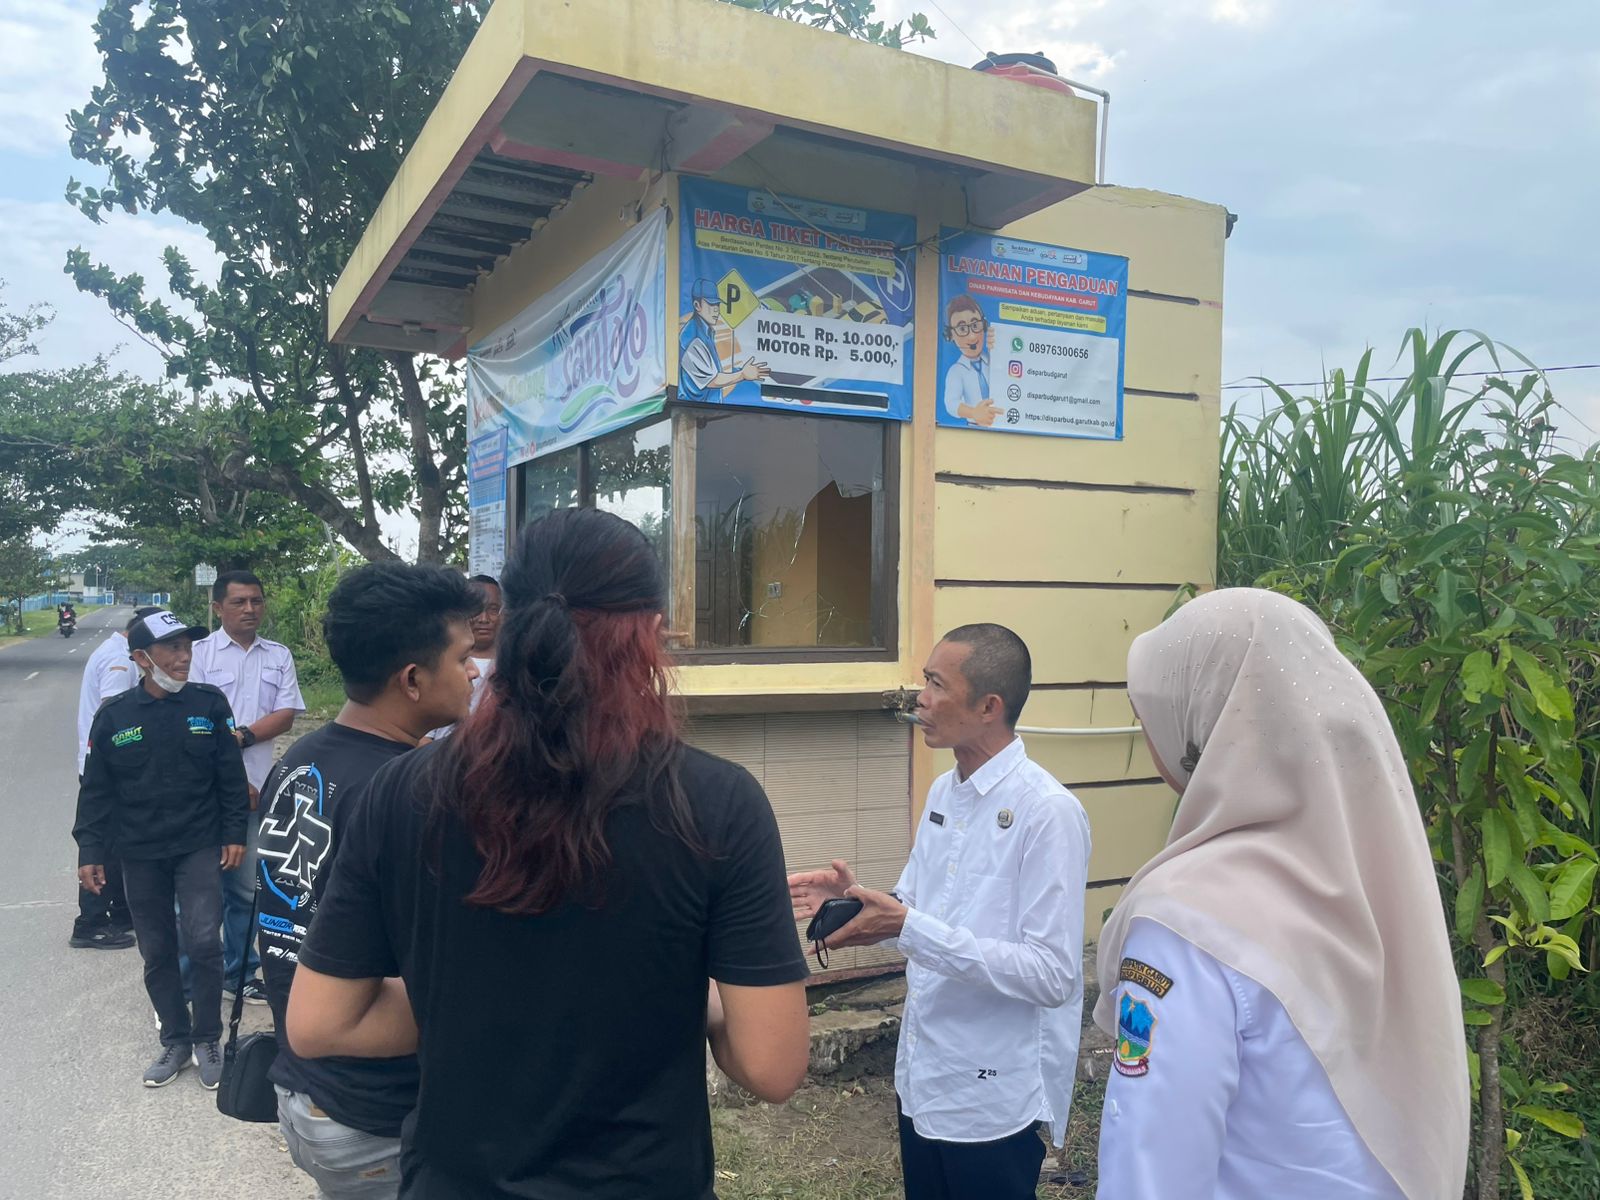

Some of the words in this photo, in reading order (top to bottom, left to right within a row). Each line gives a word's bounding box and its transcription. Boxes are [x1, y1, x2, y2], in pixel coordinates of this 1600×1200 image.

[694, 207, 766, 239] HARGA
[768, 222, 820, 248] TIKET
[711, 241, 738, 252] Peraturan
[739, 246, 753, 254] Desa
[770, 251, 785, 260] Tahun
[801, 256, 821, 266] Tentang
[720, 235, 755, 247] Berdasarkan
[822, 252, 842, 262] Tentang
[948, 255, 1022, 283] LAYANAN
[1026, 266, 1119, 297] PENGADUAN
[727, 283, 740, 314] P
[968, 281, 986, 291] DINAS
[986, 283, 1018, 296] PARIWISATA
[1018, 288, 1030, 297] DAN
[1030, 289, 1065, 302] KEBUDAYAAN
[1078, 297, 1096, 307] GARUT
[1001, 303, 1029, 313] Sampaikan
[1047, 309, 1074, 321] pertanyaan
[1021, 314, 1034, 322] Anda
[1034, 315, 1056, 326] terhadap
[1057, 318, 1076, 328] layanan
[1077, 321, 1088, 329] kami
[757, 319, 805, 339] MOBIL
[815, 327, 838, 345] Rp.
[842, 331, 899, 351] 10.000,-
[757, 337, 810, 357] MOTOR
[815, 345, 838, 362] Rp.
[850, 349, 898, 368] 5.000,-
[1029, 342, 1089, 360] 08976300656
[1026, 368, 1068, 380] disparbudgarut
[1025, 412, 1115, 428] https://disparbud.garutkab.go.id
[260, 916, 293, 931] JUNIOR
